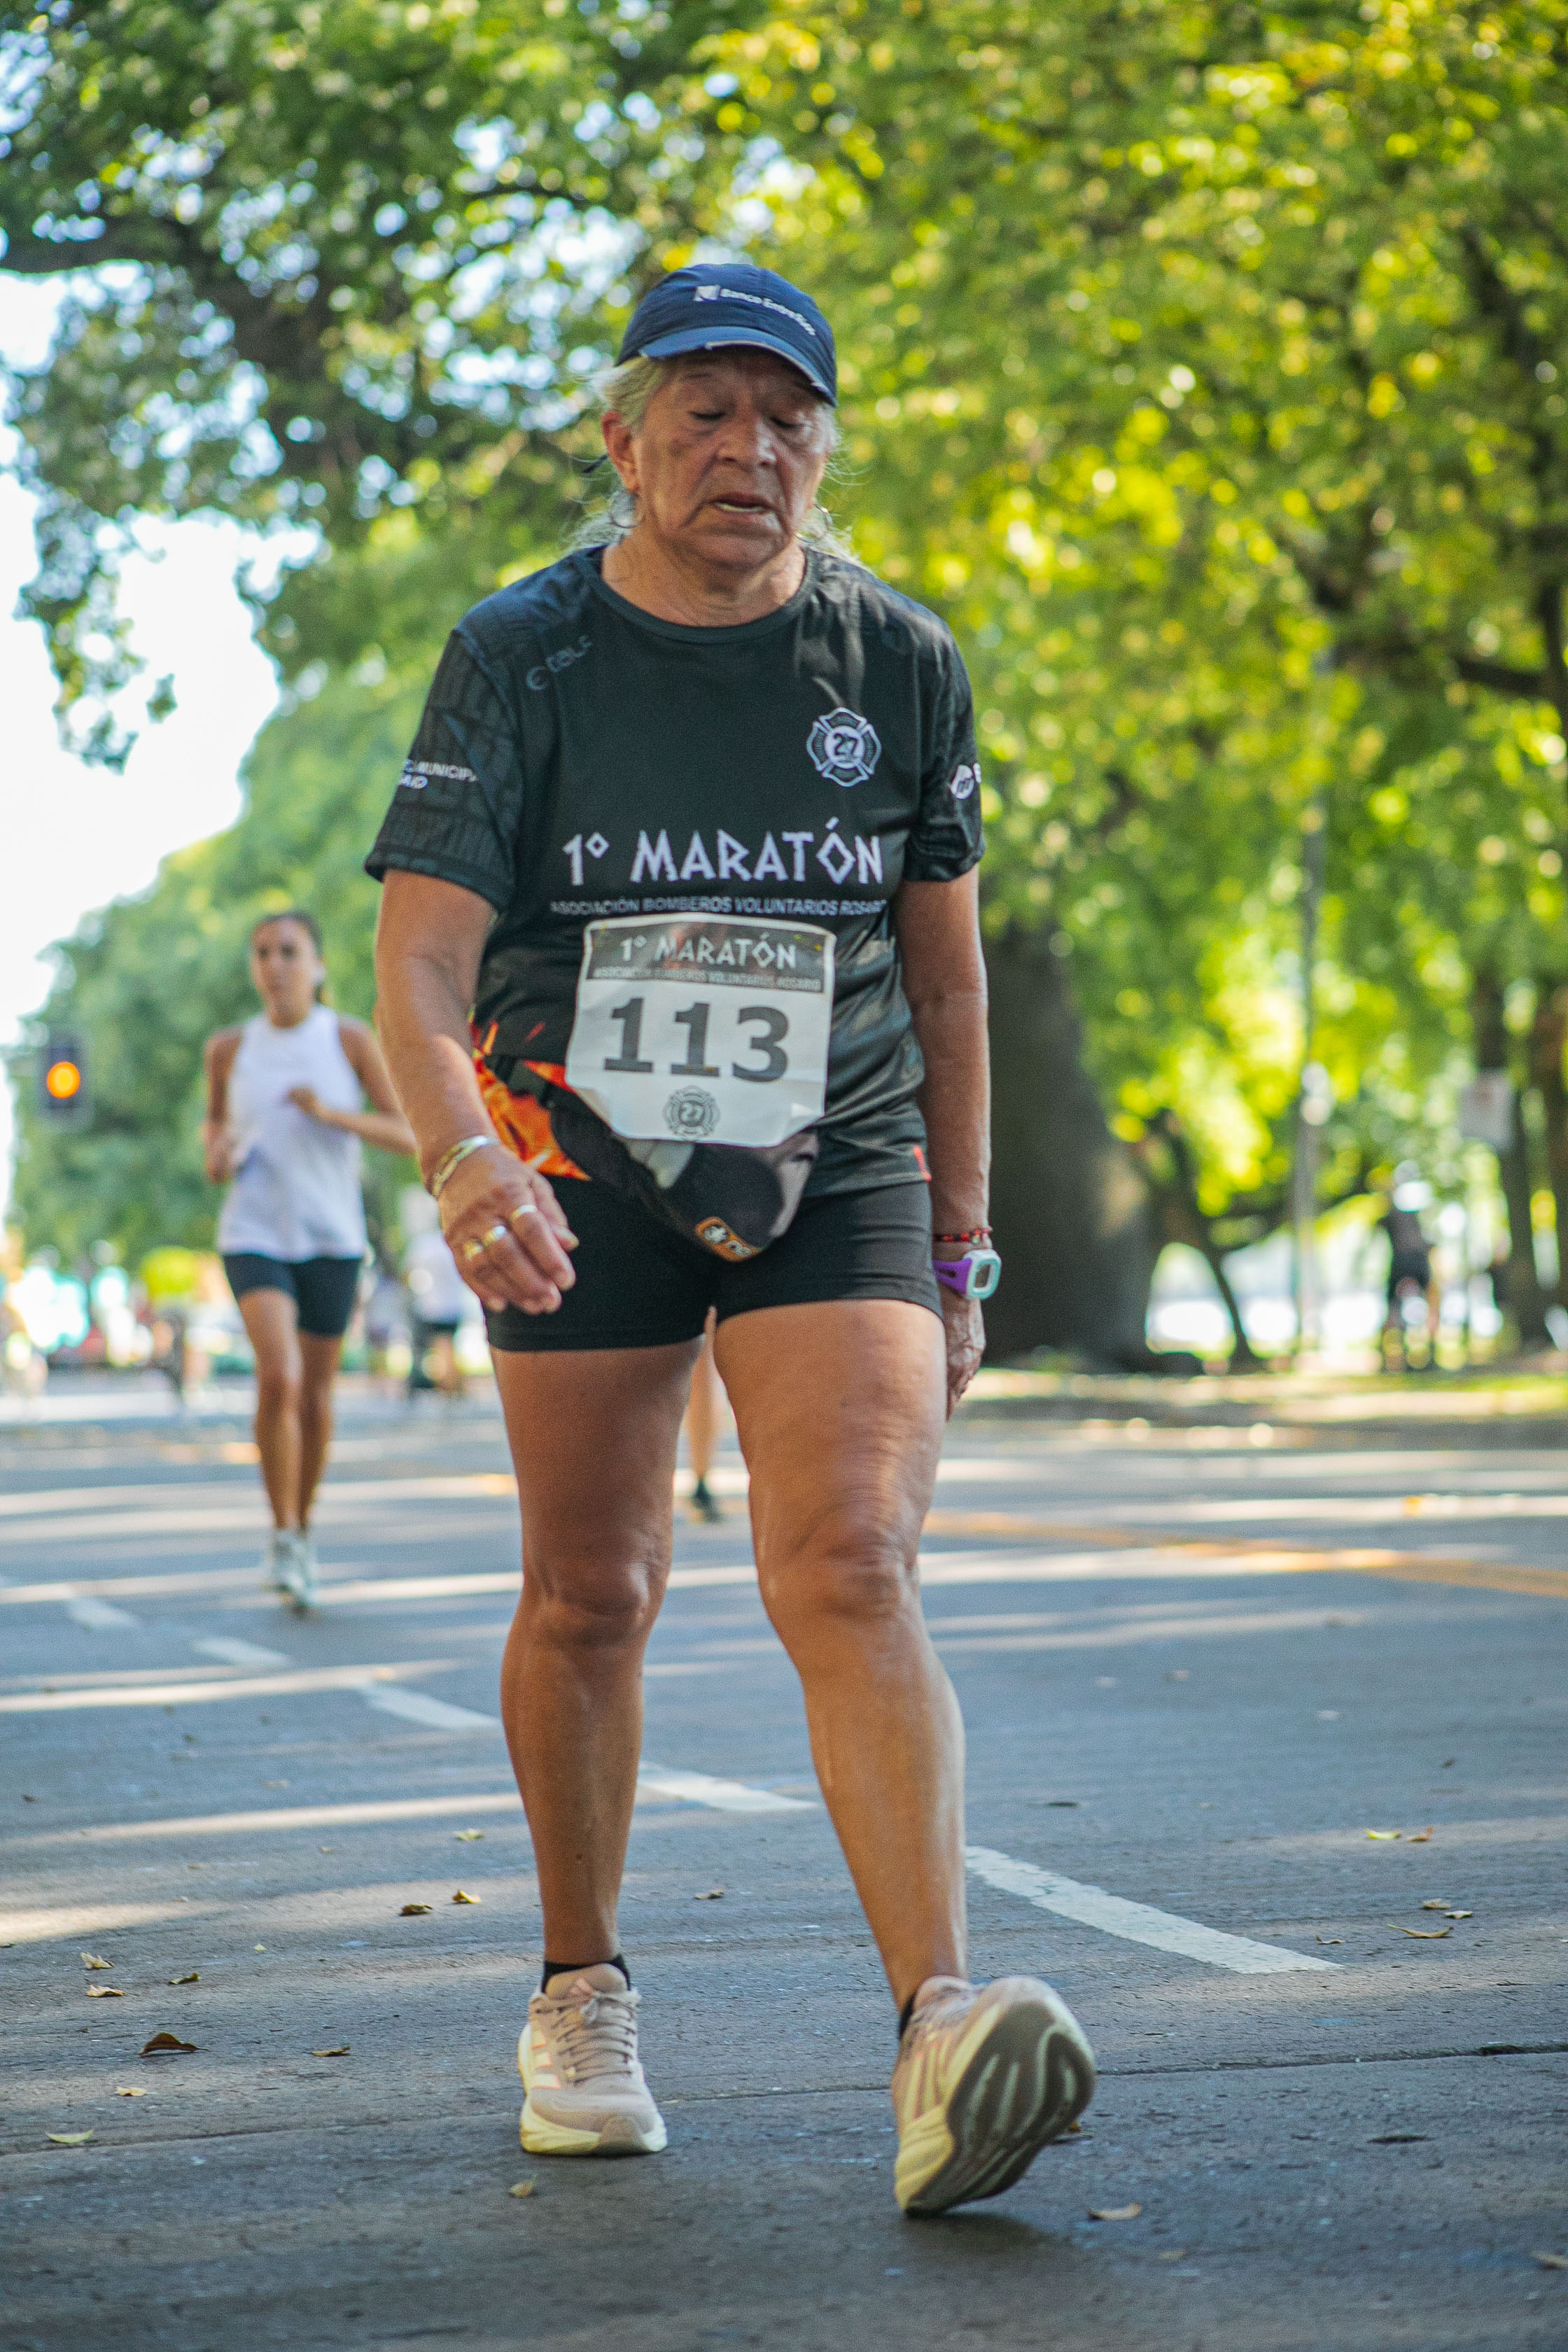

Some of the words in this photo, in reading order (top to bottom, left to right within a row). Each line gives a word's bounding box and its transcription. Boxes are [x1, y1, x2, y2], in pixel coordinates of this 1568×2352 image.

[833, 732, 858, 756] 27
[630, 816, 883, 885] MARATÓN
[643, 896, 732, 913] BOMBEROS
[734, 897, 839, 916] VOLUNTARIOS
[654, 932, 797, 969] MARATÓN
[603, 997, 790, 1083] 113
